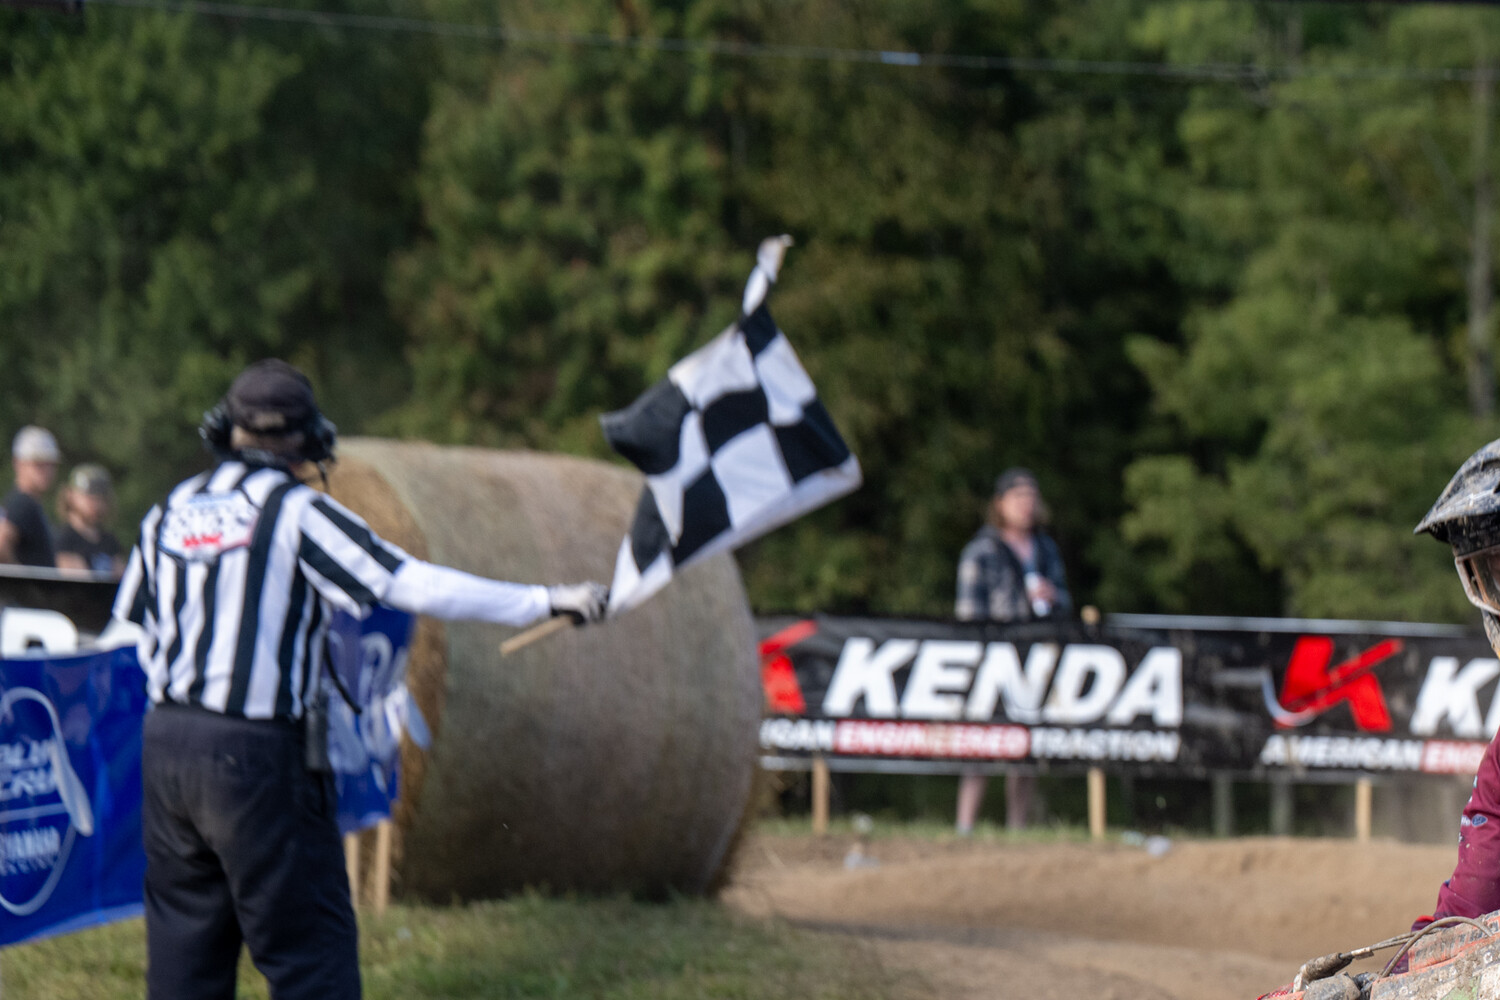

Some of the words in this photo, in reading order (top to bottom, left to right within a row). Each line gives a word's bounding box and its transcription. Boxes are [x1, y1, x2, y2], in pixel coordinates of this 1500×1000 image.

[823, 636, 1182, 727] KENDA
[839, 720, 1030, 758] ENGINEERED
[1030, 727, 1180, 762] TRACTION
[1260, 734, 1423, 771] AMERICAN
